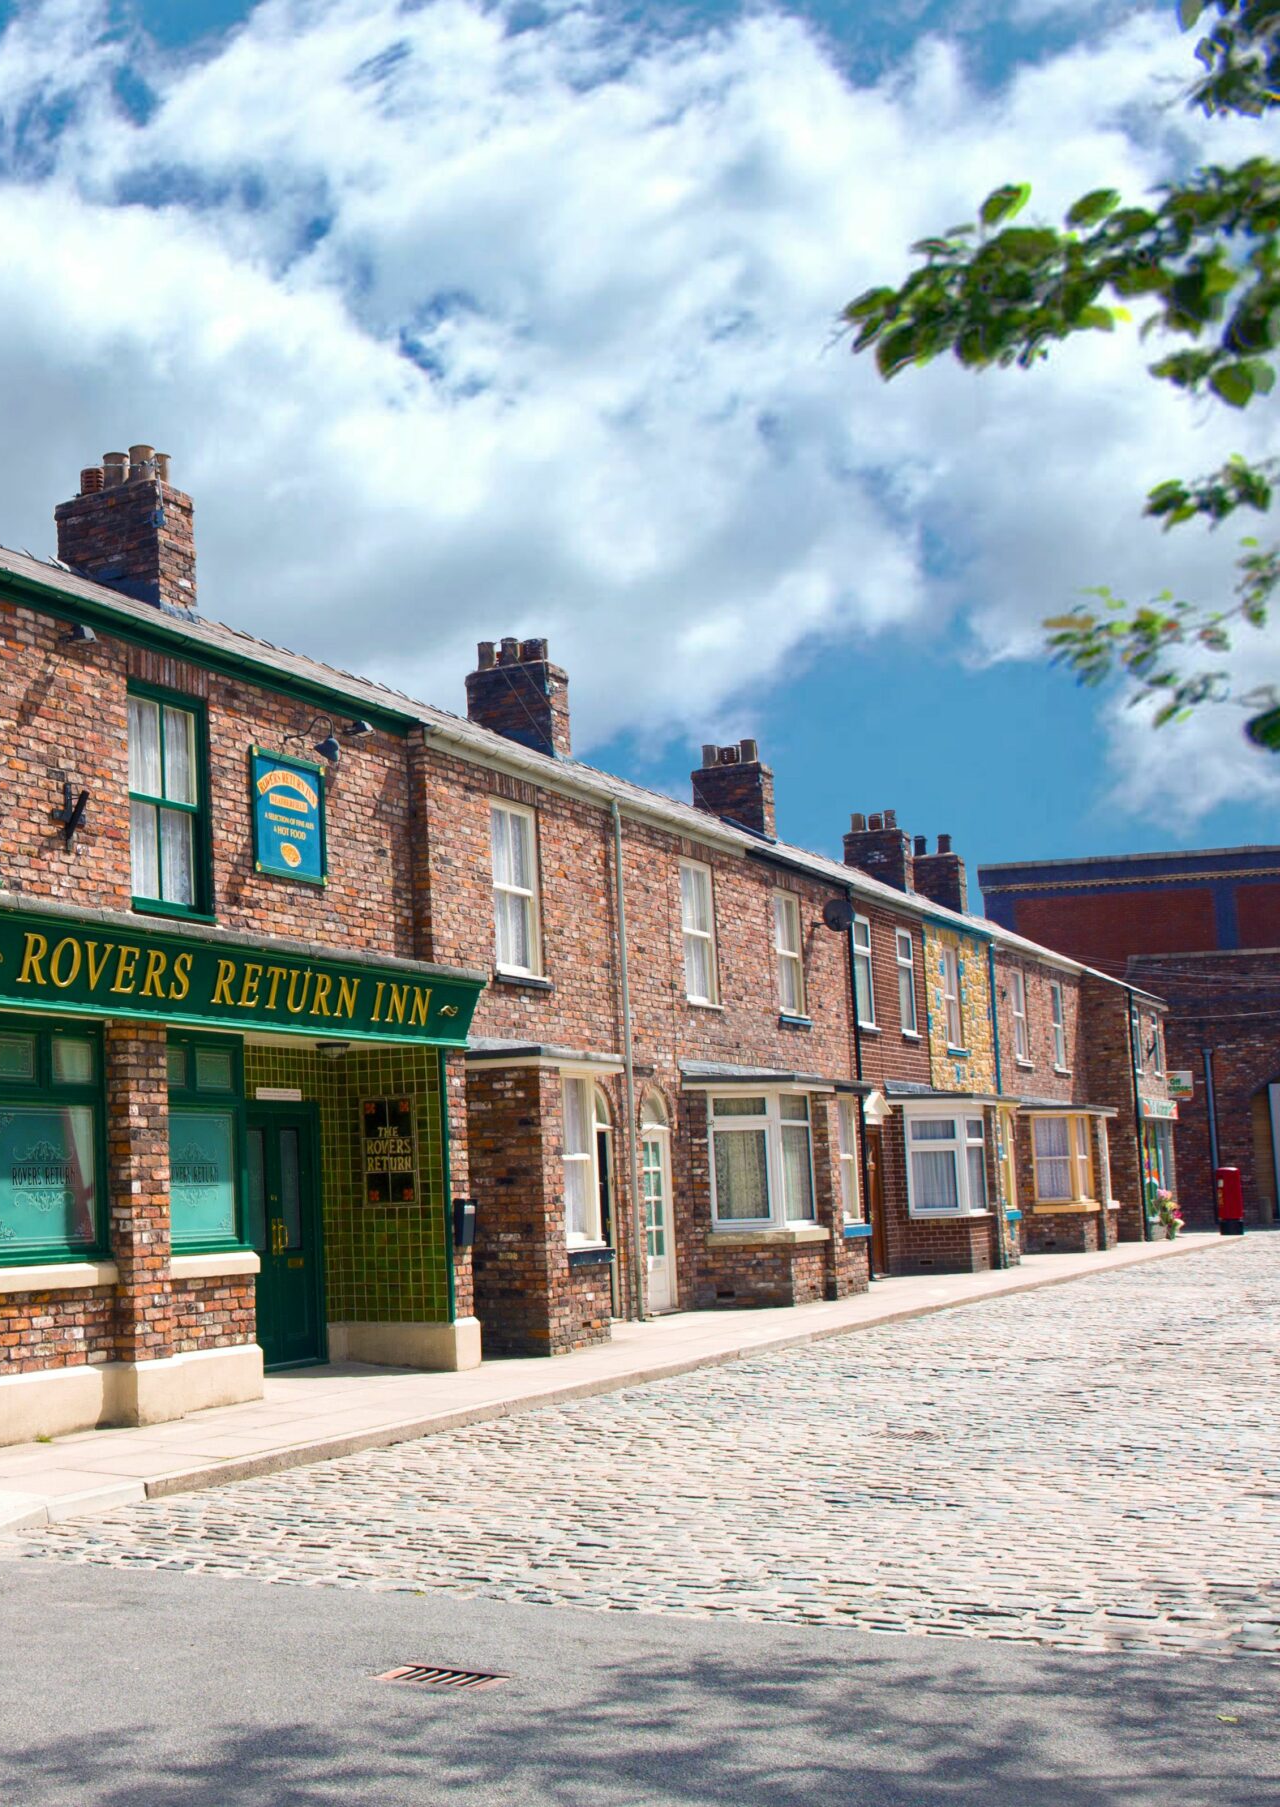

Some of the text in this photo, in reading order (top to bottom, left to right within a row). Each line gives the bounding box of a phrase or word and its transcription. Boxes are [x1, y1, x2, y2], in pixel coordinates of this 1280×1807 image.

[278, 826, 289, 836] HOT
[290, 829, 306, 839] FOOD
[16, 932, 433, 1027] ROVERS RETURN INN
[377, 1126, 400, 1137] THE
[366, 1139, 412, 1154] ROVERS
[367, 1156, 413, 1171] RETURN
[12, 1167, 77, 1185] ROVERS RETURN
